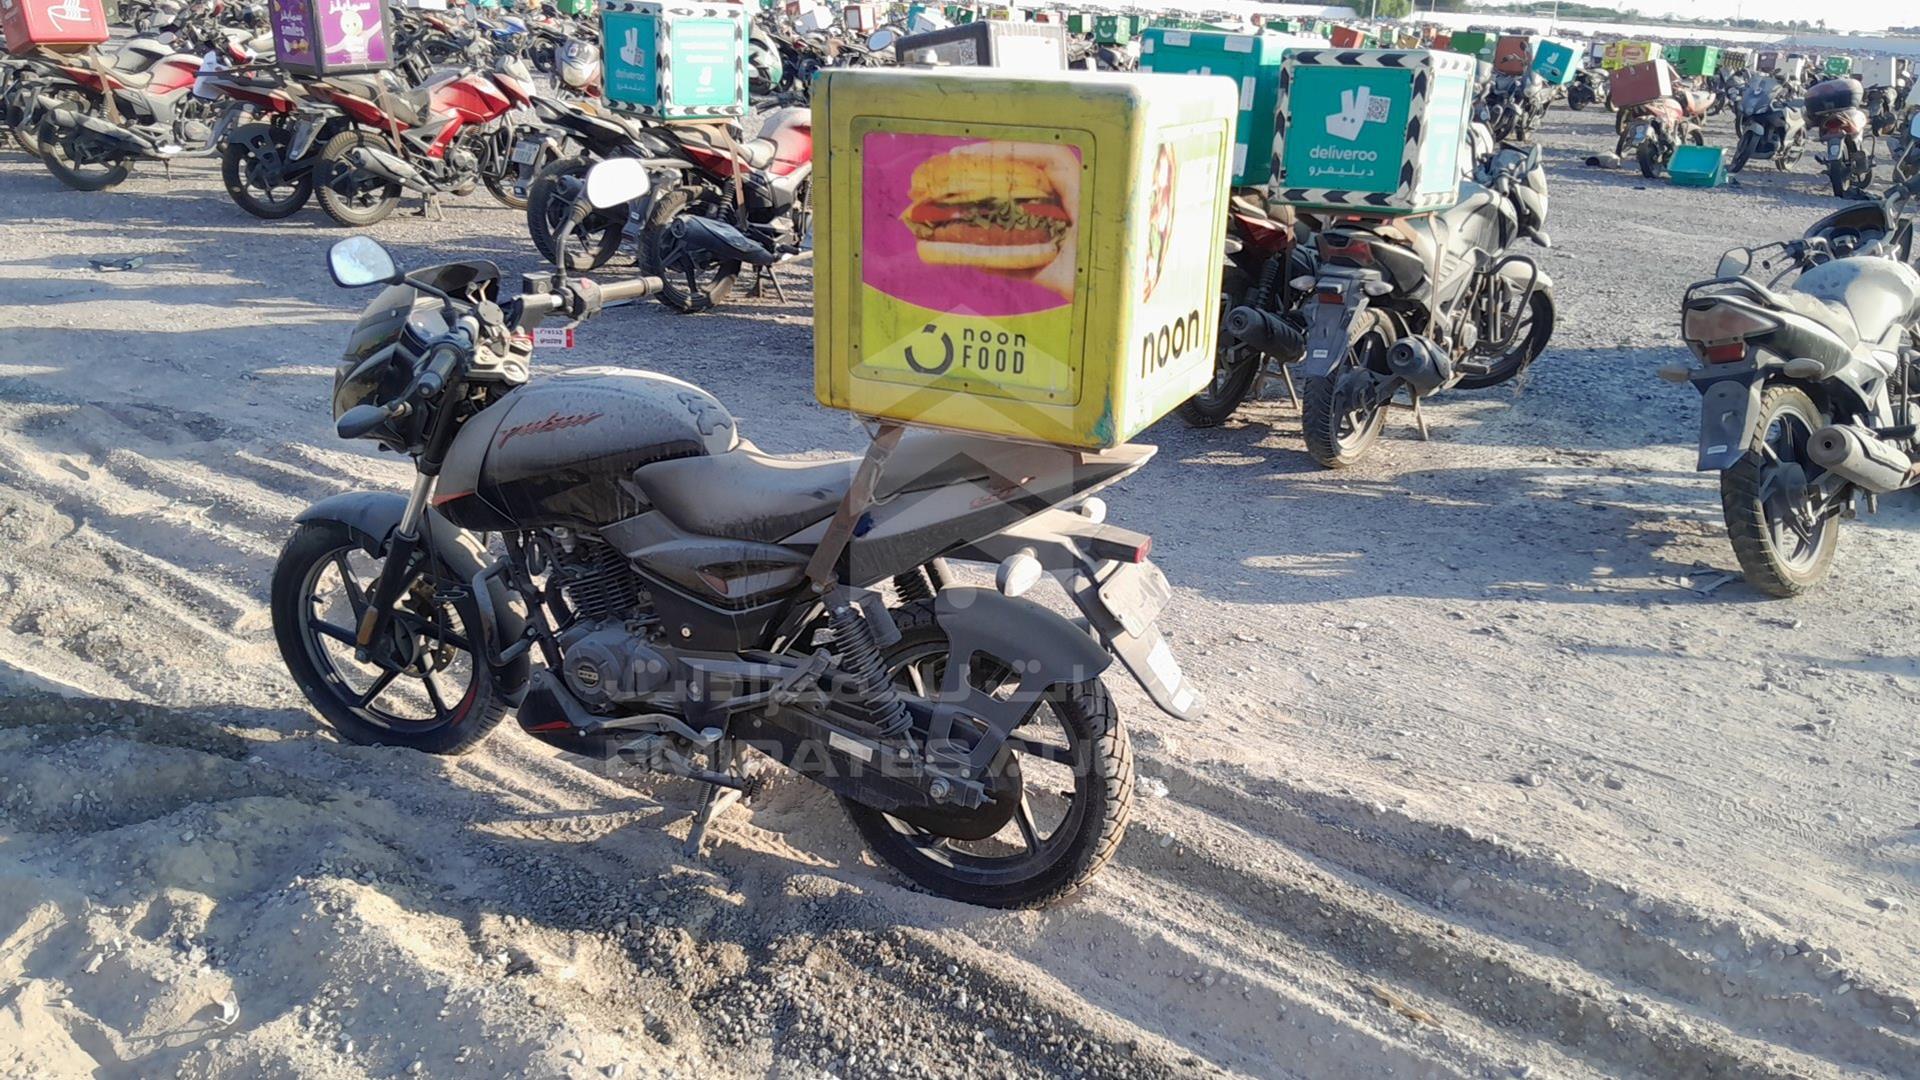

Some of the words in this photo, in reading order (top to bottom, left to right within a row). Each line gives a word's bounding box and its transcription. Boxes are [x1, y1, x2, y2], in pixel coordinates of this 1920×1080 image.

[1309, 145, 1378, 161] deliveroo
[1308, 163, 1375, 179] ديليفرو
[963, 328, 1026, 347] noon
[1141, 309, 1200, 379] noon
[962, 346, 1025, 374] FOOD
